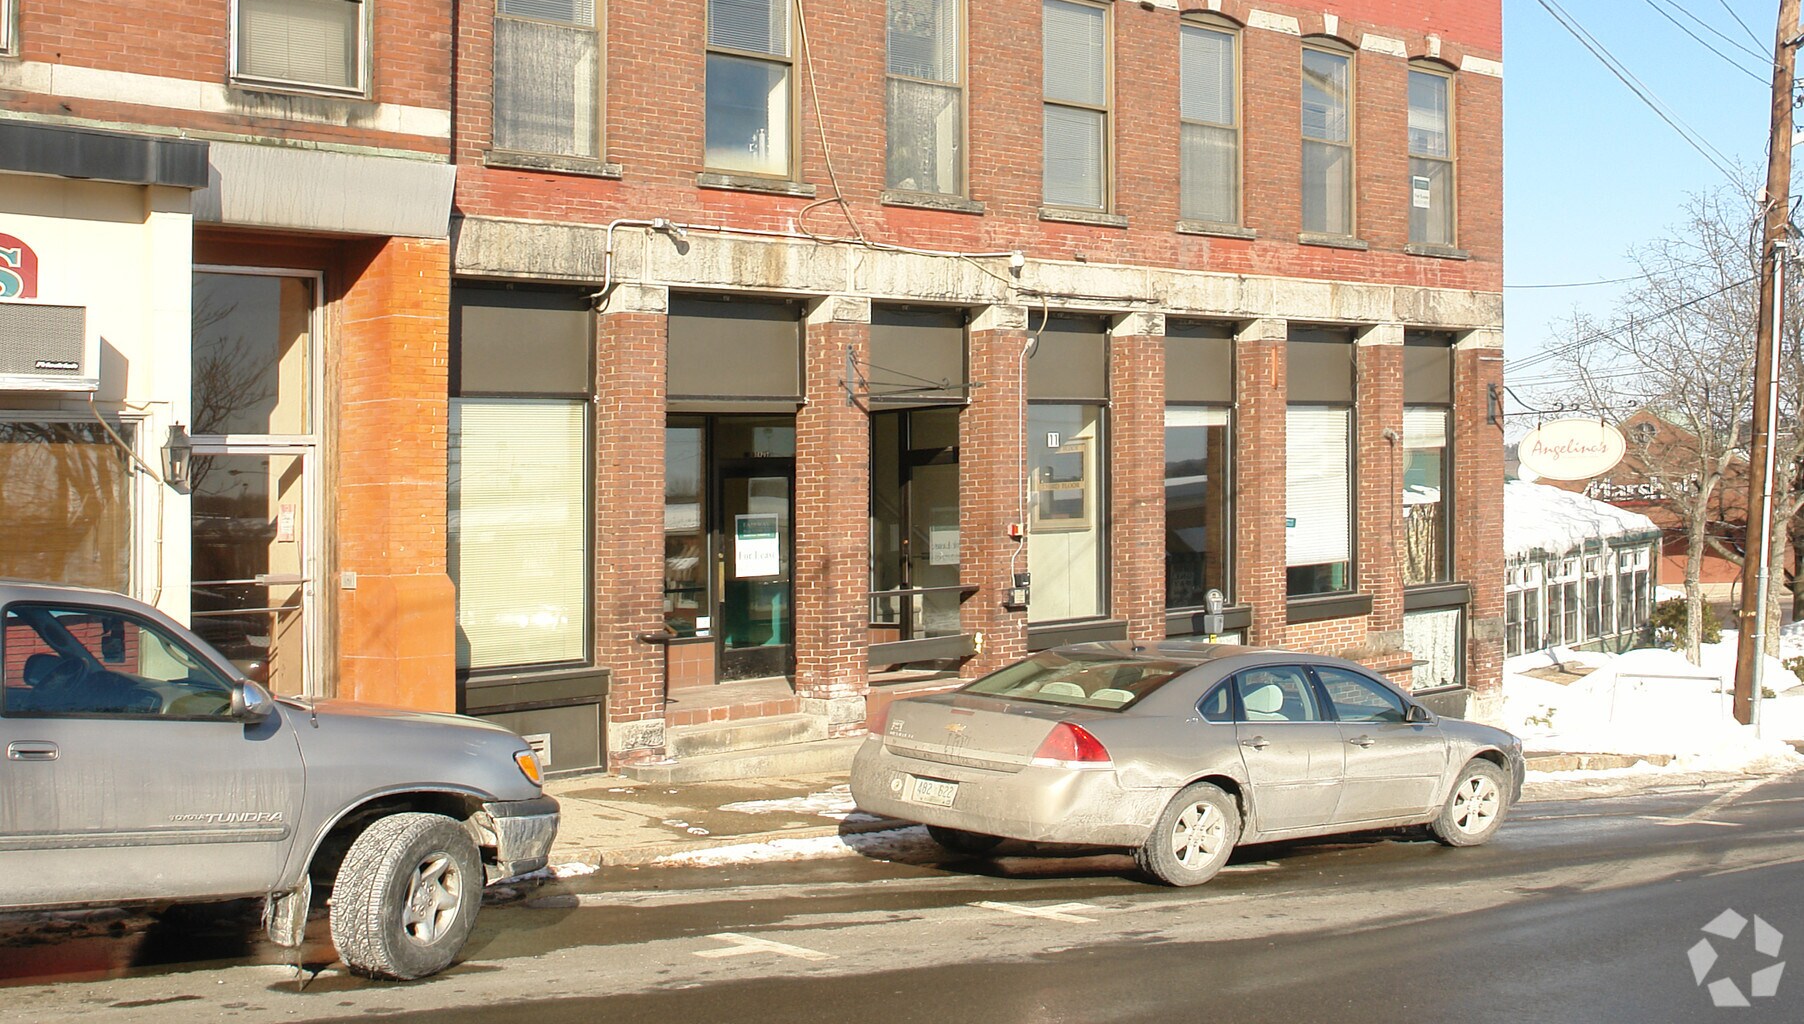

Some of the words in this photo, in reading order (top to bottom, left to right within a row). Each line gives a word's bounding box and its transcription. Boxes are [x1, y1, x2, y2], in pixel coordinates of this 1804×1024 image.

[1049, 434, 1058, 446] 11
[1531, 438, 1609, 460] Angelina's
[917, 781, 933, 795] 482
[938, 785, 954, 799] 622
[168, 814, 205, 822] TOYOTA
[206, 812, 283, 824] TUNDRA
